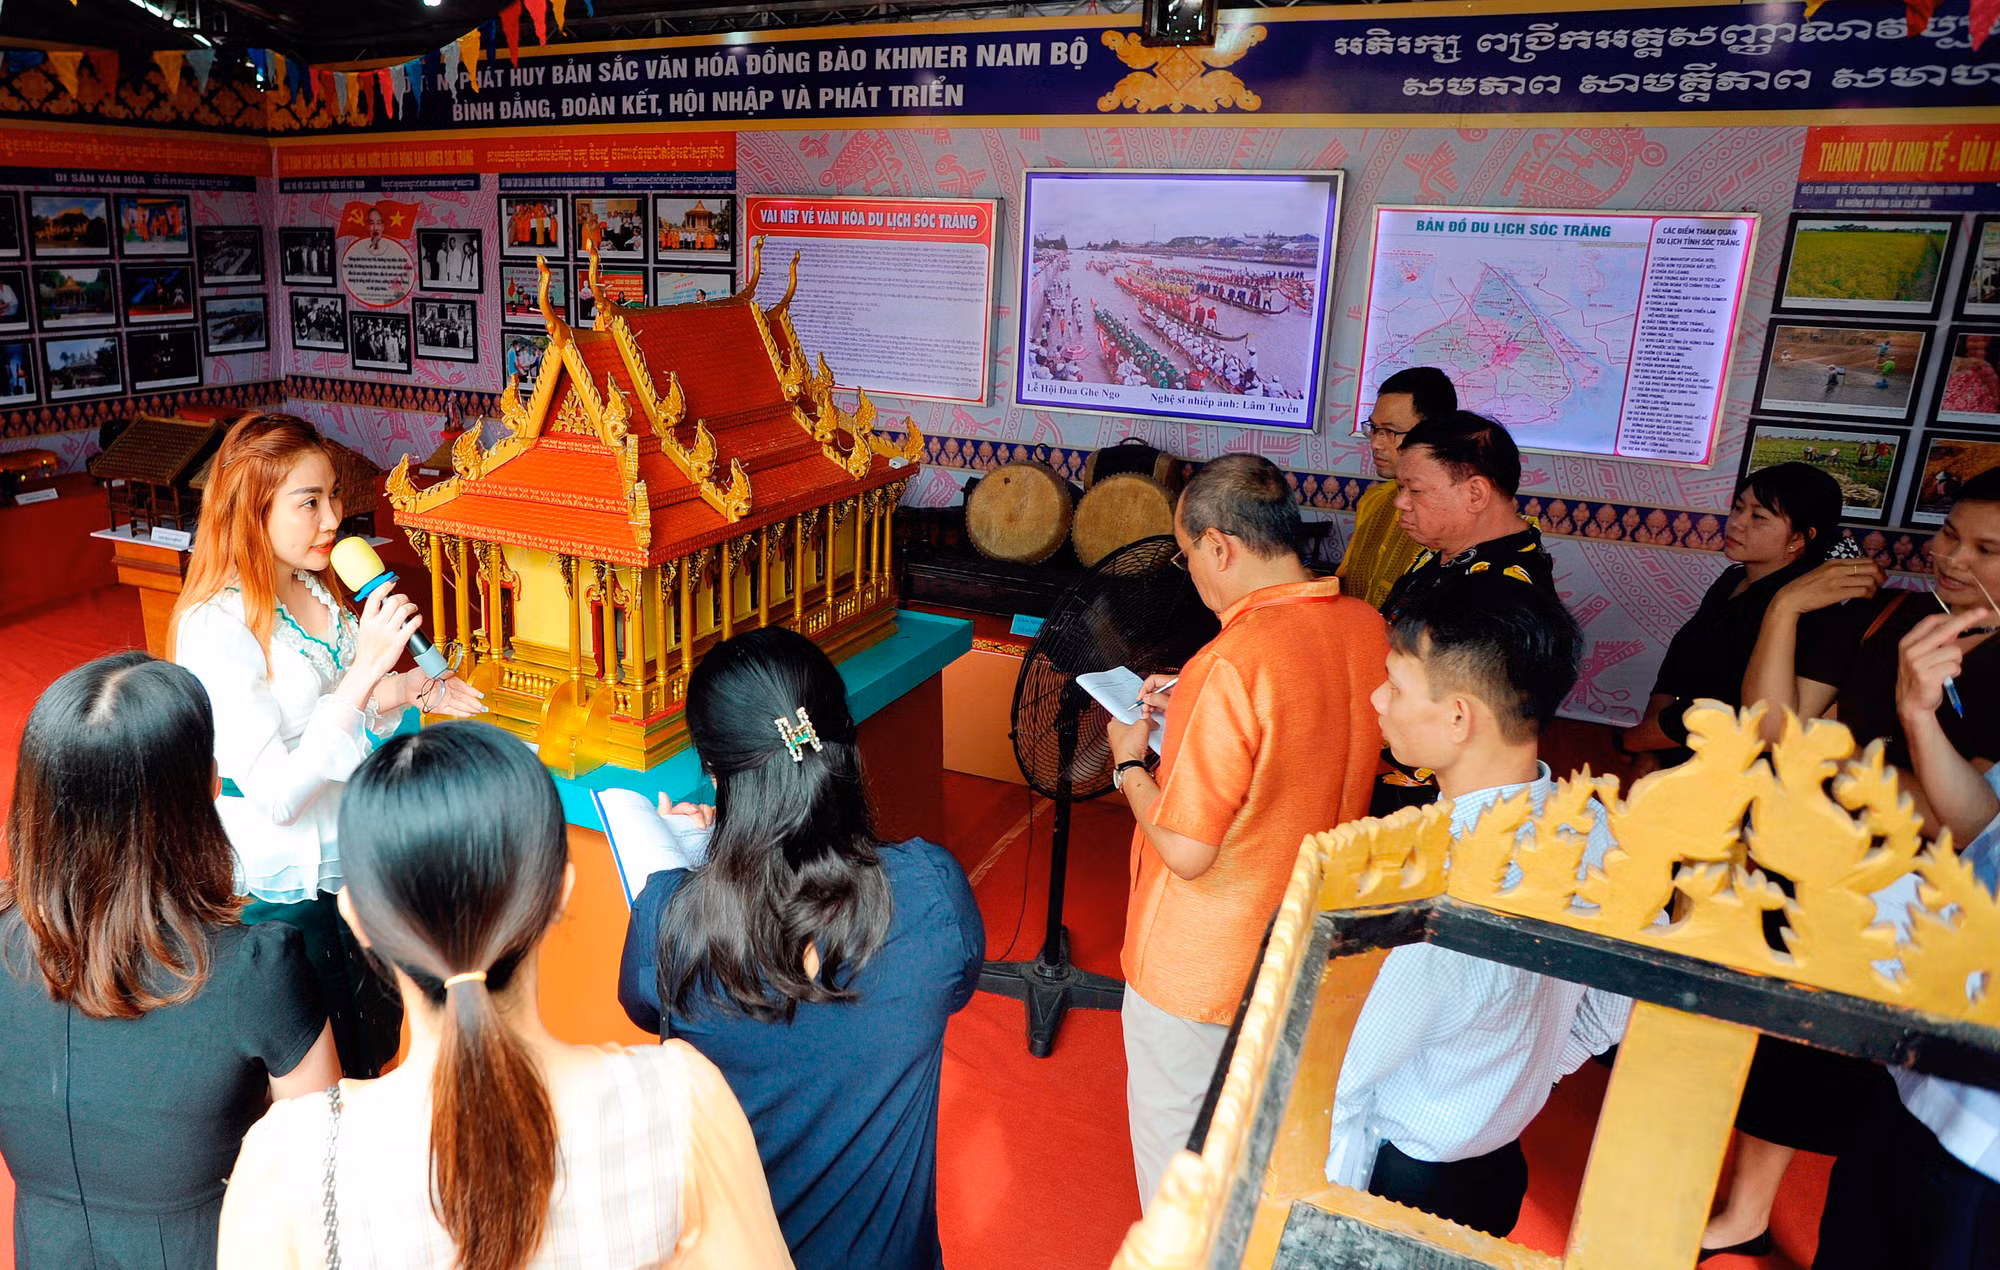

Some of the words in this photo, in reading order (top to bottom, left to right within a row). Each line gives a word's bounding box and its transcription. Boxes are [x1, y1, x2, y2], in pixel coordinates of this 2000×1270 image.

[510, 66, 545, 86] HUY
[552, 58, 596, 84] BẢN
[598, 54, 639, 82] SẮC
[645, 55, 688, 80] VĂN
[695, 51, 740, 78] HÓA
[746, 46, 810, 75] ĐỒNG
[818, 45, 867, 72] BÀO
[875, 45, 967, 71] KHMER
[976, 41, 1040, 67] NAM
[1050, 36, 1089, 70] BỘ
[453, 98, 494, 122] BÌNH
[500, 91, 556, 120] ĐẲNG,
[562, 92, 616, 117] ĐOÀN
[622, 88, 663, 117] KẾT,
[669, 89, 705, 117] HỘI
[712, 86, 774, 115] NHẬP
[781, 84, 812, 110] VÀ
[820, 82, 881, 108] PHÁT
[889, 75, 963, 107] TRIỂN
[1818, 135, 1865, 172] THÀNH
[1891, 141, 1929, 172] KINH
[1929, 131, 1953, 172] TẾ
[760, 208, 778, 223] VÀI
[780, 207, 800, 224] NÉT
[802, 206, 815, 224] VỀ
[817, 208, 839, 225] VĂN
[841, 207, 866, 226] HÓA
[868, 211, 884, 227] DU
[886, 212, 911, 231] LỊCH
[913, 210, 936, 228] SÓC
[938, 210, 978, 230] TRĂNG
[1416, 217, 1444, 232] BẢN
[1449, 217, 1467, 233] ĐỒ
[1471, 221, 1489, 234] DU
[1494, 222, 1526, 237] LỊCH
[1529, 220, 1559, 236] SÓC
[1563, 222, 1612, 238] TRĂNG
[1027, 380, 1038, 393] Lễ
[1040, 384, 1057, 395] Hội
[1059, 387, 1078, 396] Đua
[1080, 387, 1099, 397] Ghe
[1102, 389, 1120, 399] Ngo
[1150, 393, 1175, 406] Nghệ
[1177, 395, 1185, 405] sĩ
[1187, 394, 1215, 408] nhiếp
[1243, 400, 1265, 411] Lâm
